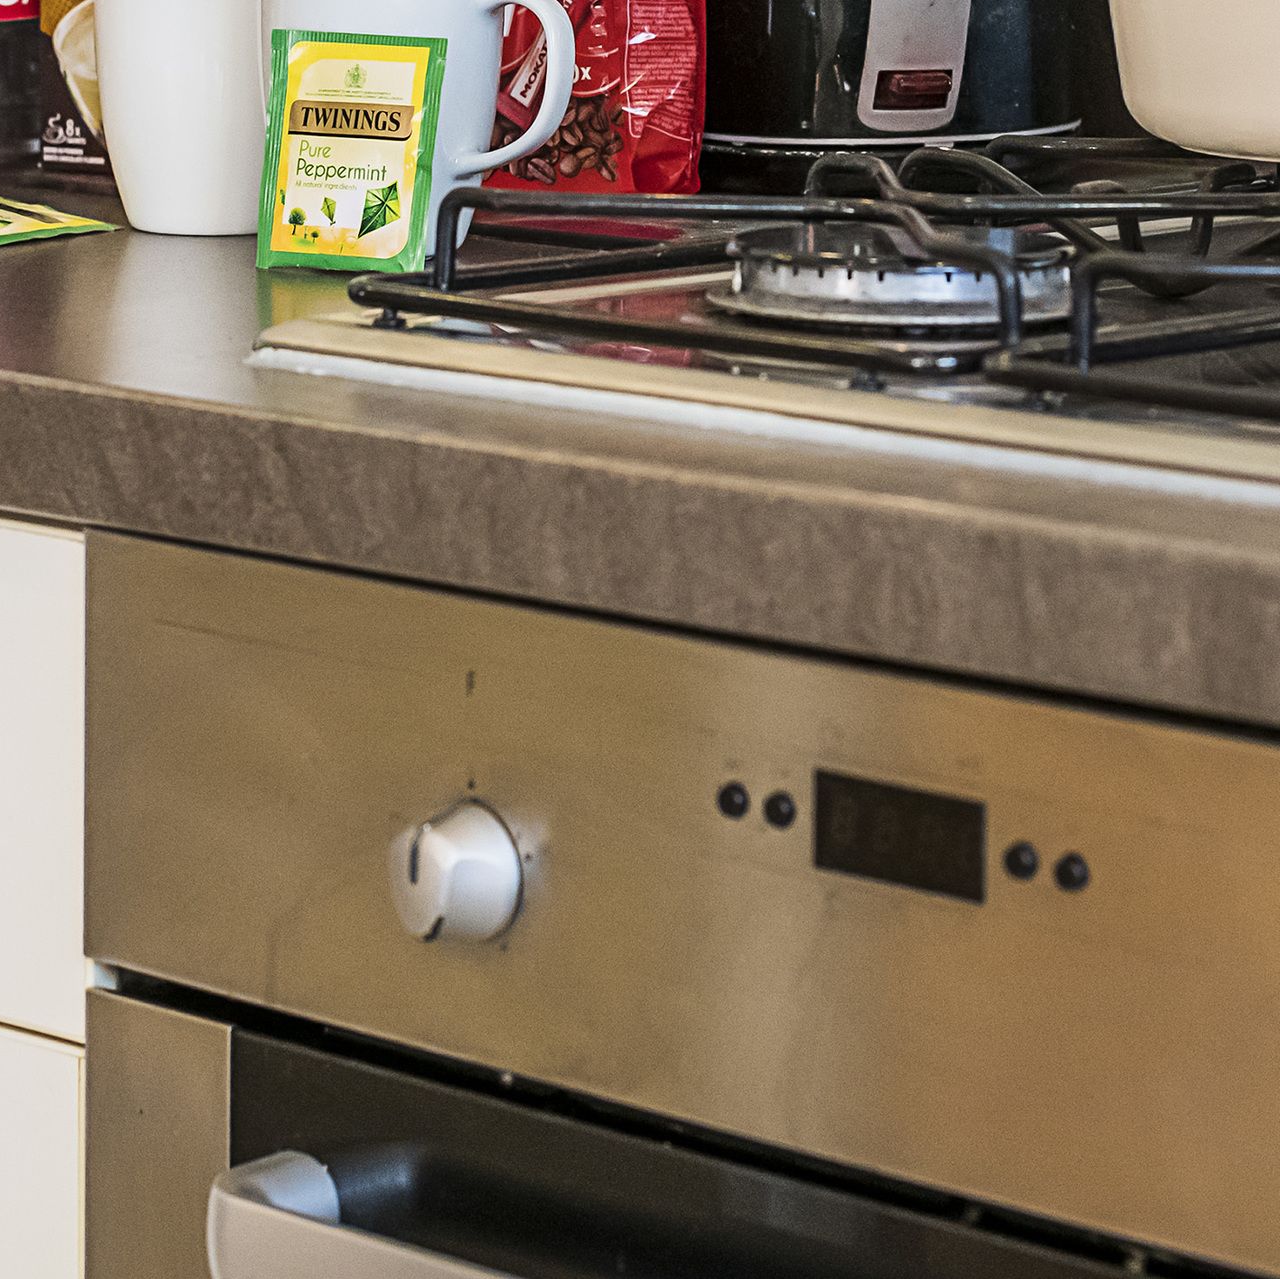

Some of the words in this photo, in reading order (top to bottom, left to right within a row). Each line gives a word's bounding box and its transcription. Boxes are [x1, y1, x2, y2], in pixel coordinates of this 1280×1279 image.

[301, 106, 401, 132] TWININGS
[299, 139, 331, 158] Pure
[296, 157, 387, 181] Peppermint
